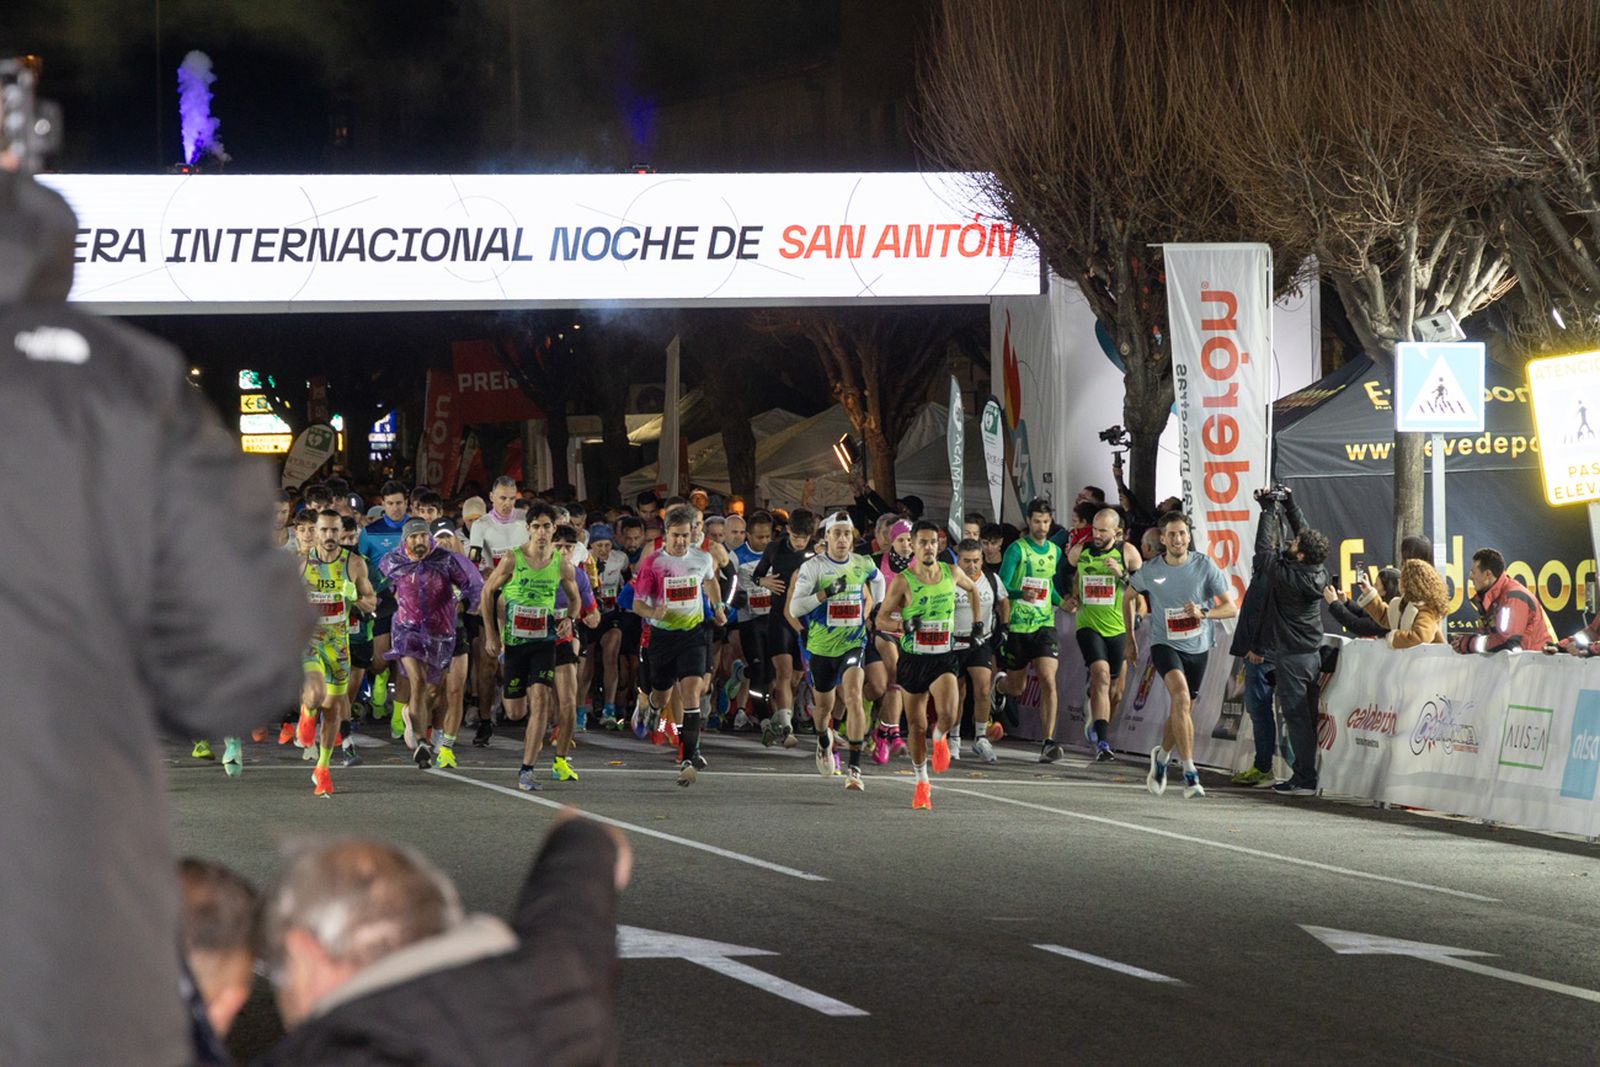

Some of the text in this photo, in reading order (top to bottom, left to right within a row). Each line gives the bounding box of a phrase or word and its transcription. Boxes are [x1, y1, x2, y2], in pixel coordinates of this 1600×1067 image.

[165, 226, 534, 263] INTERNACIONAL
[550, 225, 699, 261] NOCHE
[708, 225, 764, 260] DE
[778, 224, 866, 259] SAN
[873, 213, 1018, 258] ANTÓN
[1554, 481, 1600, 500] ELEV
